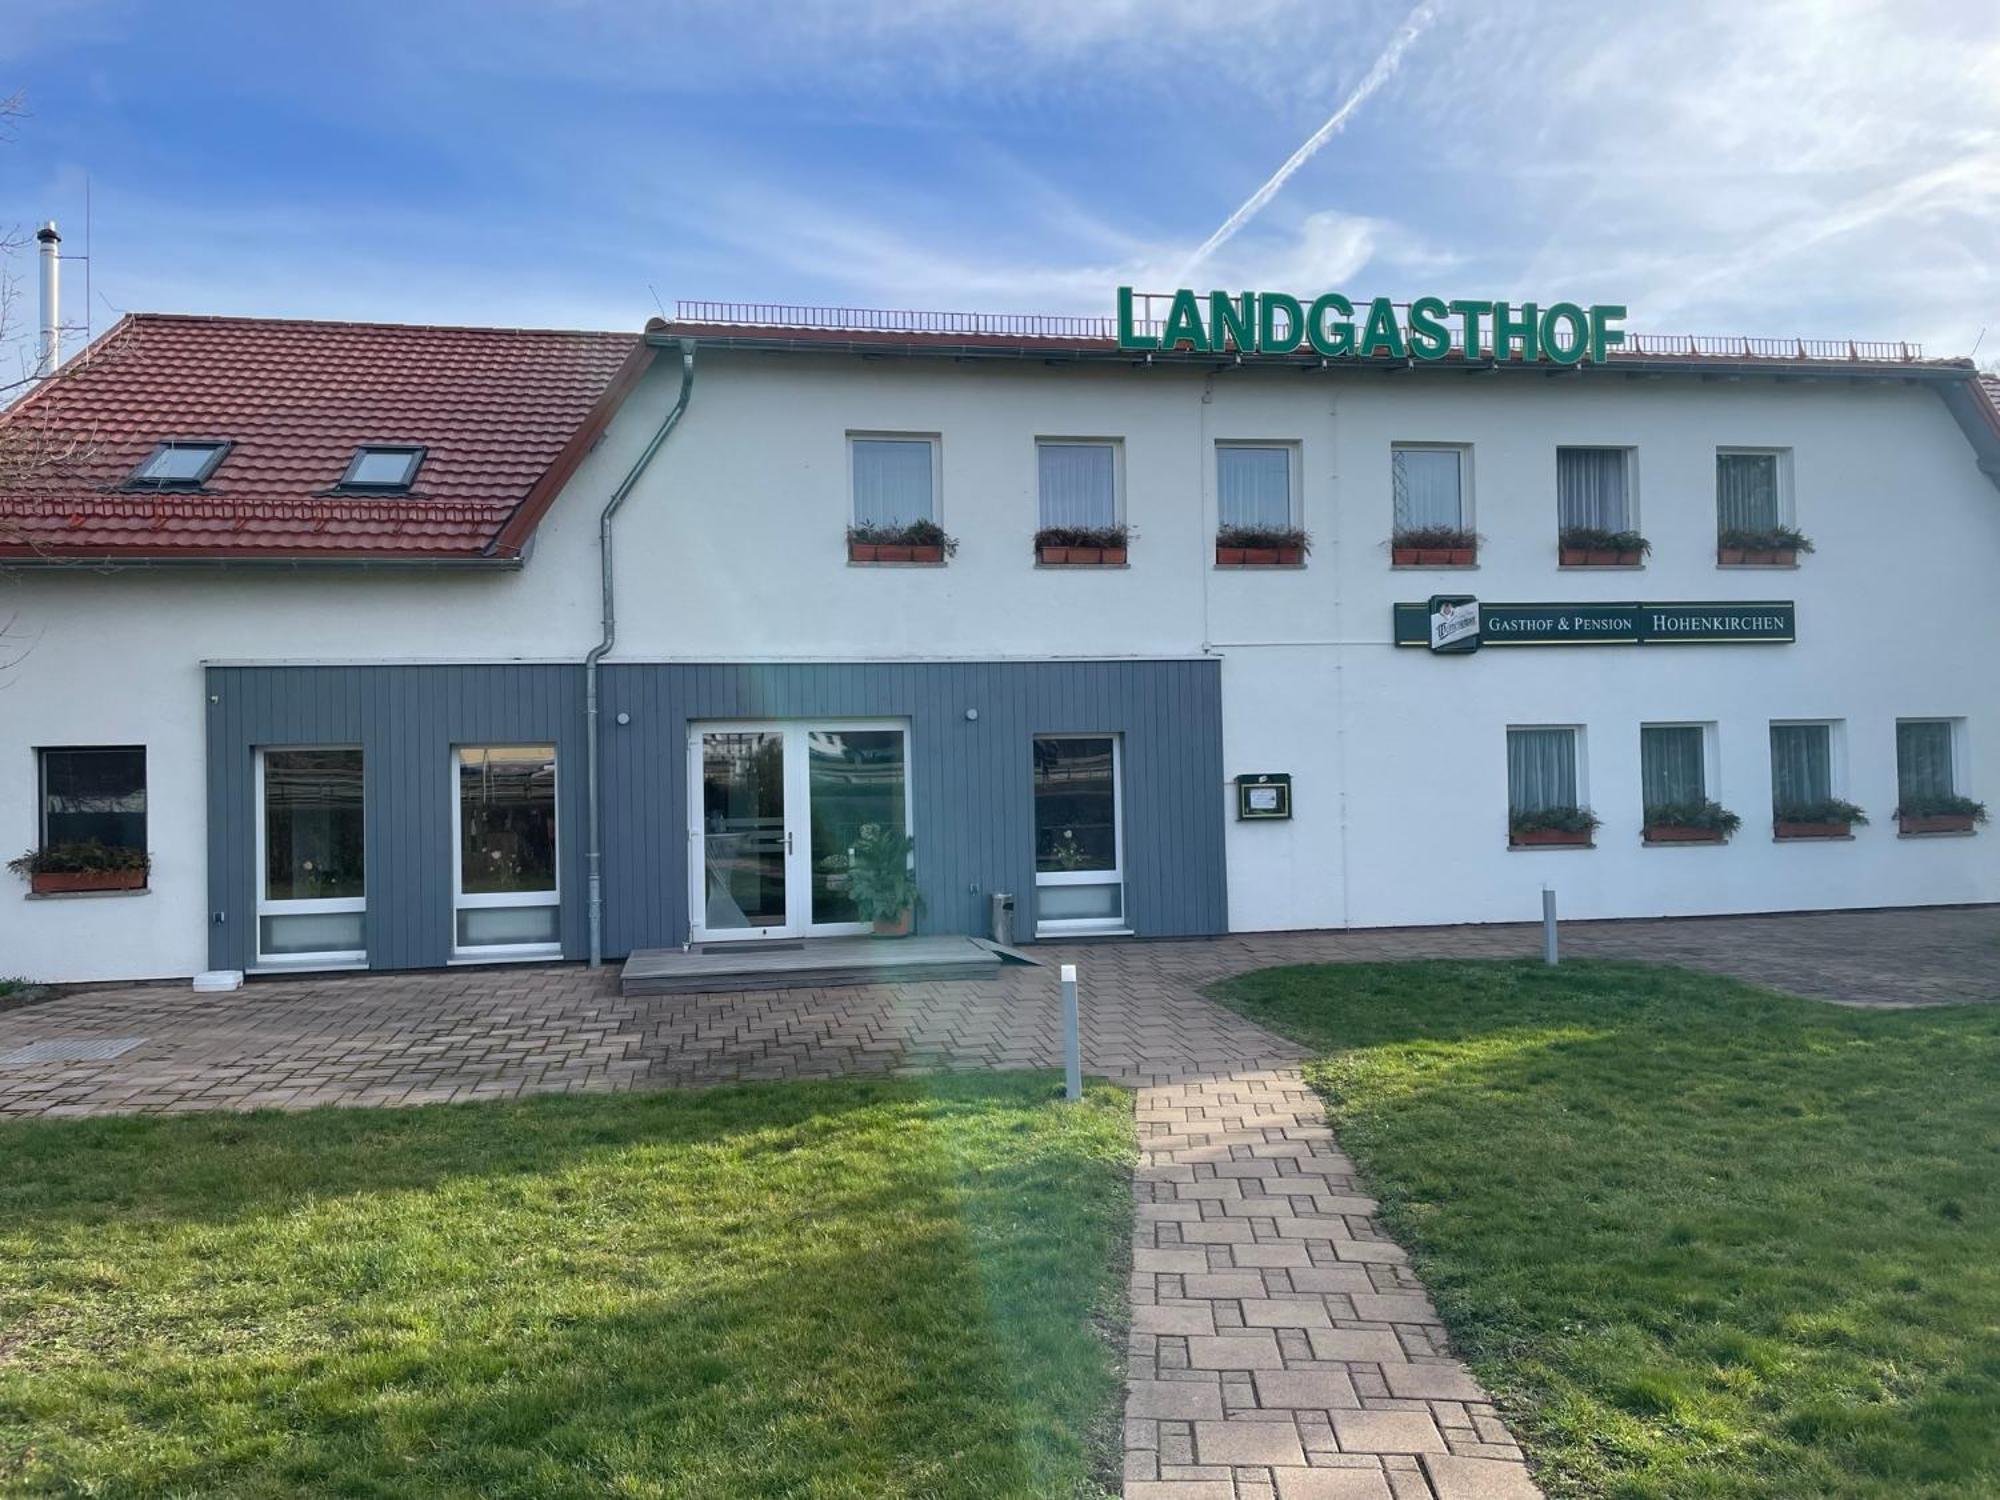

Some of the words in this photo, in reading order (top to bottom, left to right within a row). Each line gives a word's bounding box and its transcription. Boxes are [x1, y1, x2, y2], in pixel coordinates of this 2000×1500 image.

[1117, 286, 1627, 364] LANDGASTHOF
[1488, 617, 1554, 631] GASTHOF
[1558, 617, 1570, 630] &
[1575, 616, 1632, 630] PENSION
[1653, 615, 1785, 631] HOHENKIRCHEN
